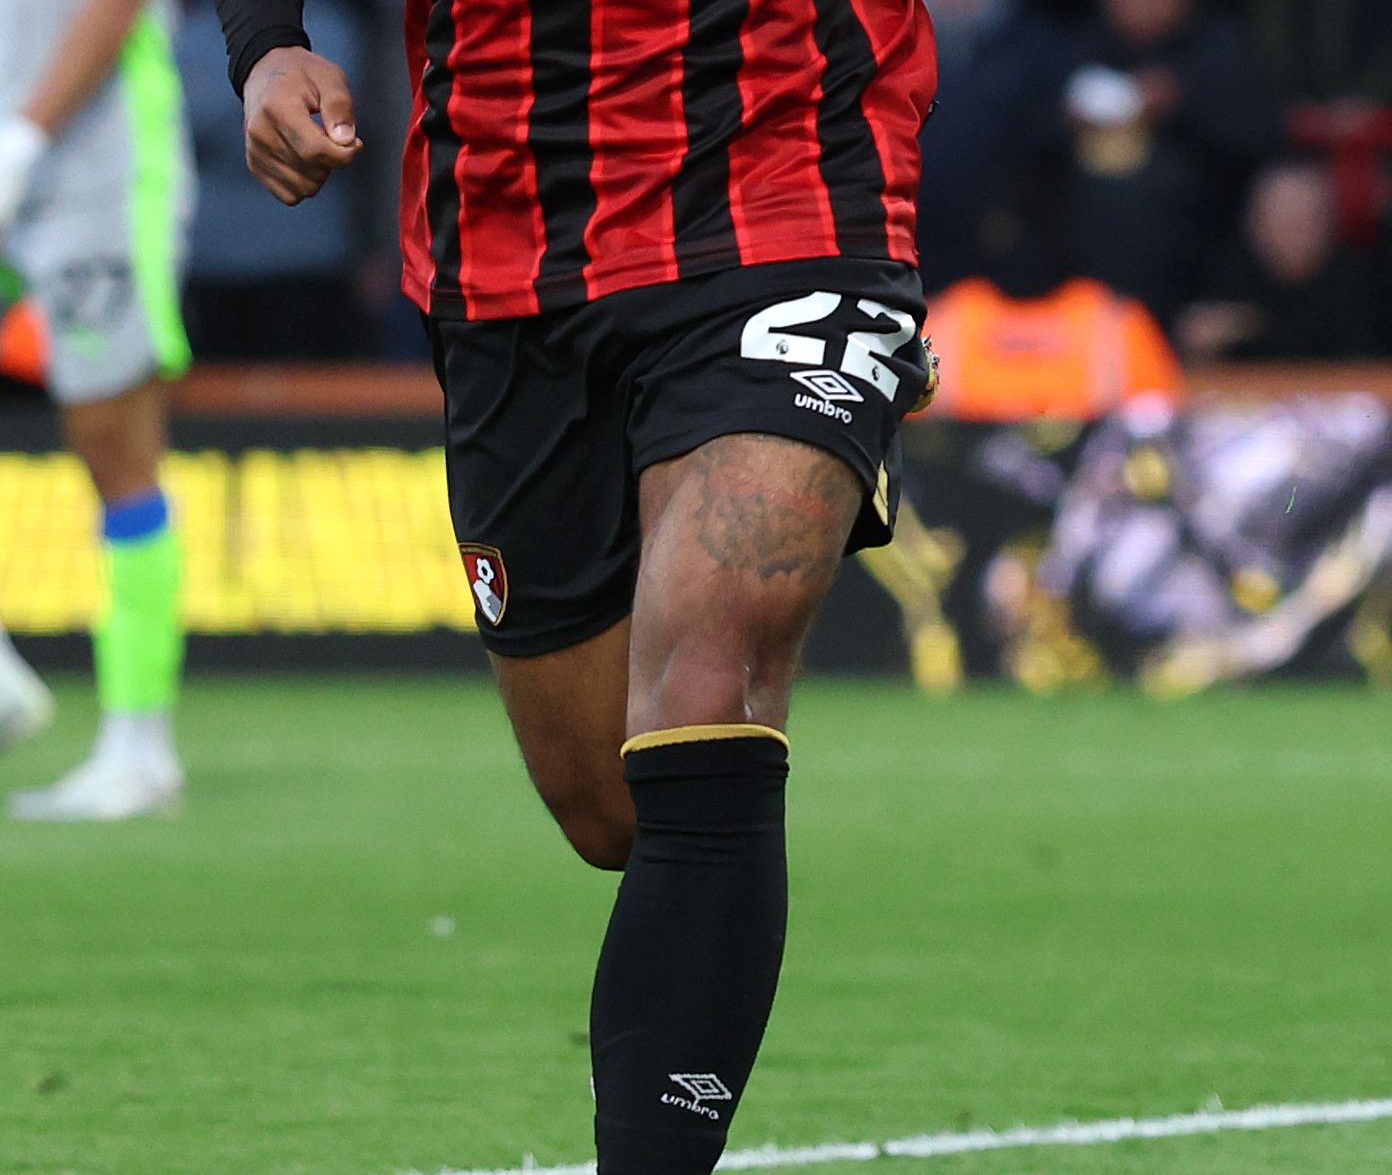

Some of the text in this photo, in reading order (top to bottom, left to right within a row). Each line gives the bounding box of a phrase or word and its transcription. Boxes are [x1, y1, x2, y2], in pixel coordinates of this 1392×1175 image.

[740, 290, 917, 403] 22
[794, 392, 853, 424] umbro
[660, 1091, 721, 1121] umbro
